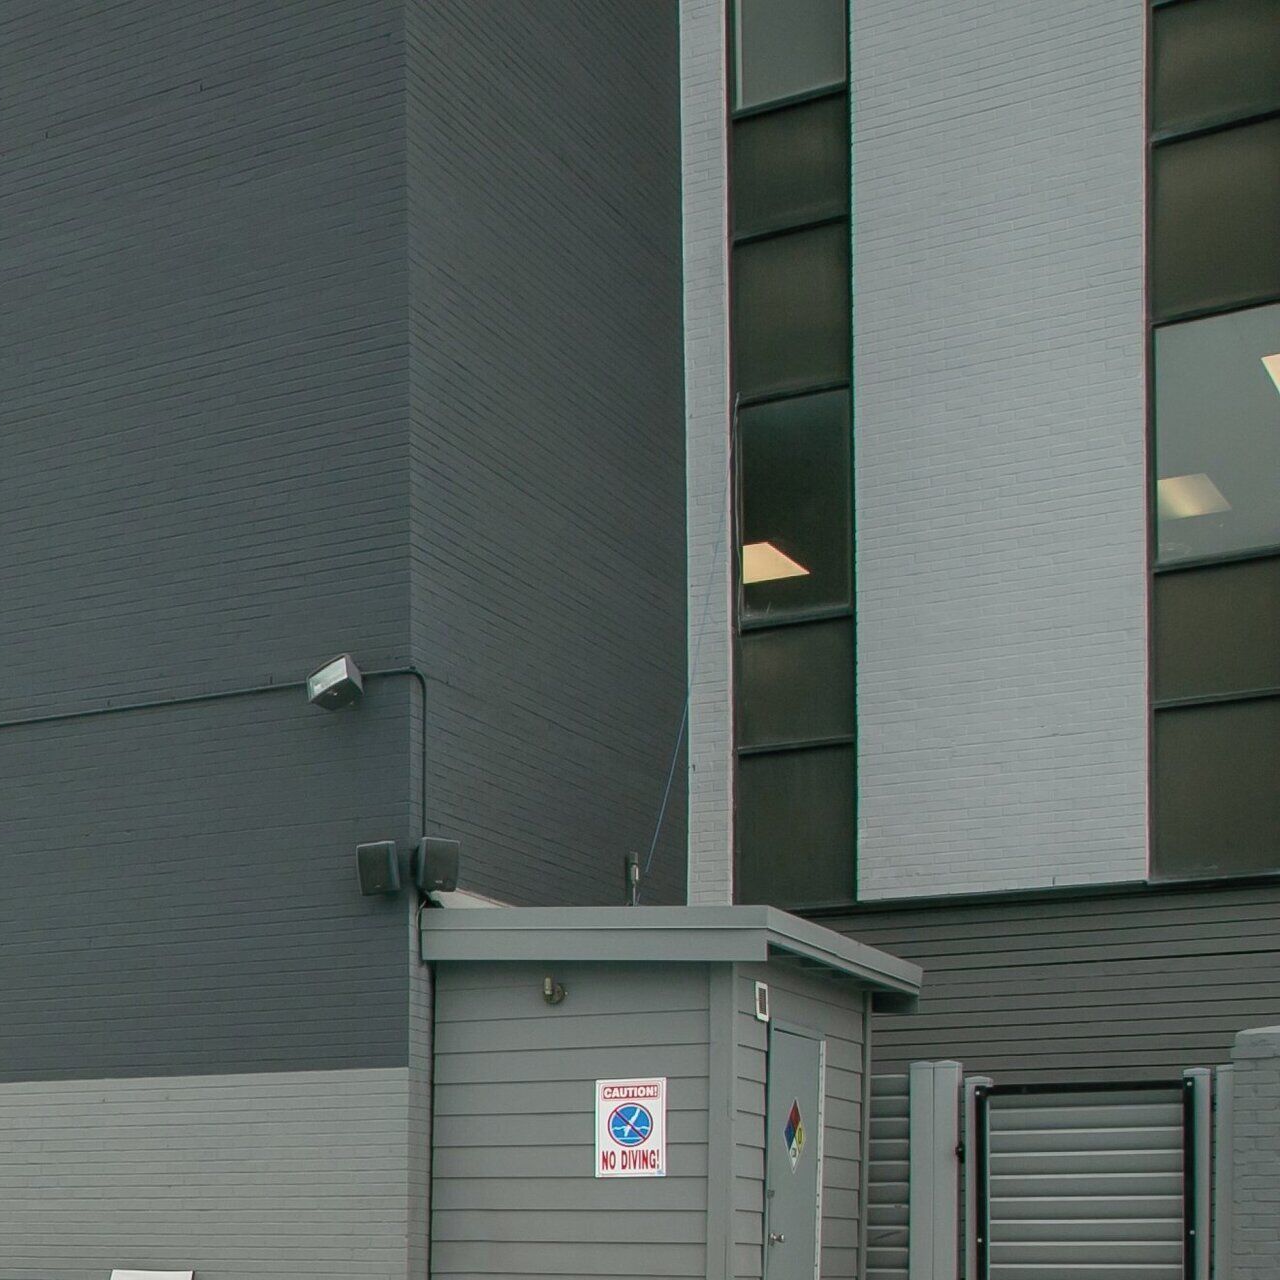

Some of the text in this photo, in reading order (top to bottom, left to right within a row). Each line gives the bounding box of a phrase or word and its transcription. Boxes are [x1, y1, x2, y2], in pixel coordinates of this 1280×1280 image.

[603, 1086, 658, 1099] CAUTION!
[602, 1149, 660, 1170] NO DIVING!
